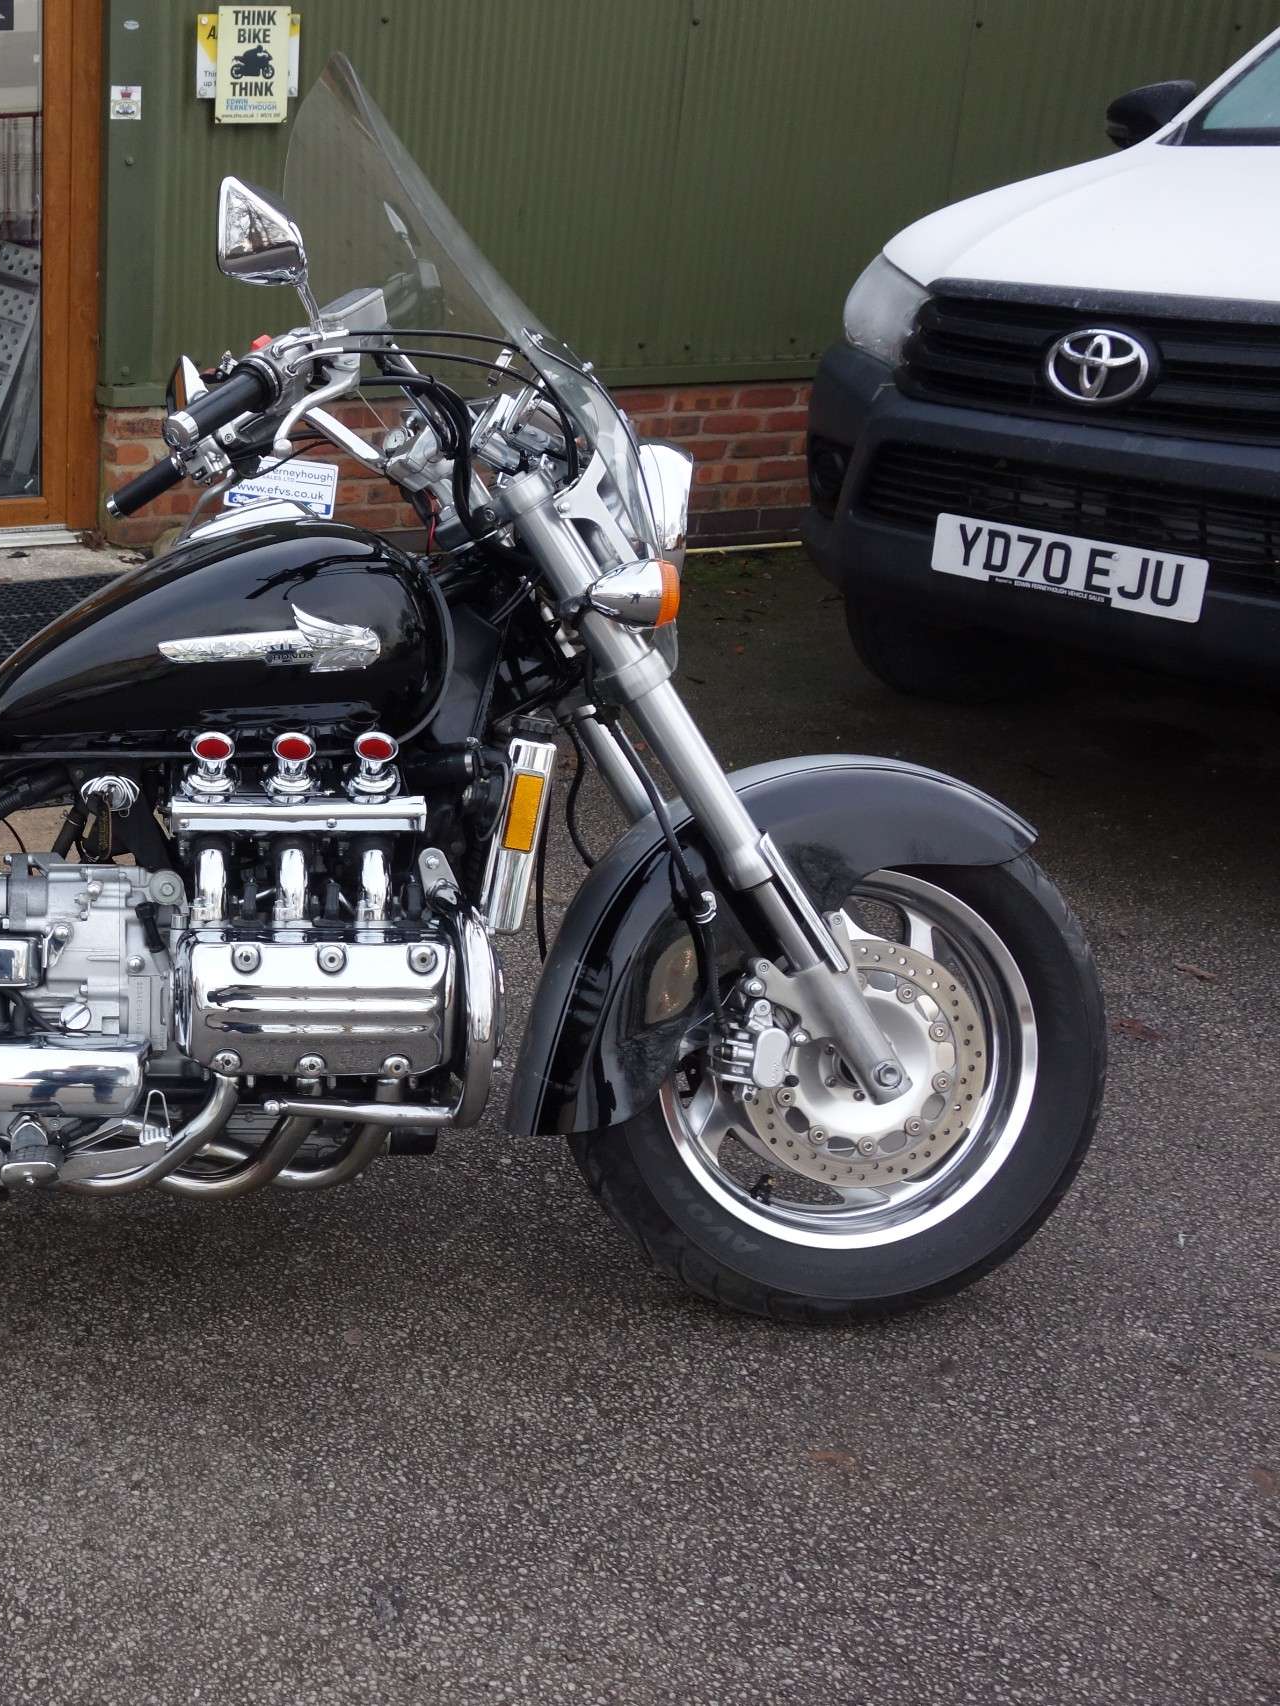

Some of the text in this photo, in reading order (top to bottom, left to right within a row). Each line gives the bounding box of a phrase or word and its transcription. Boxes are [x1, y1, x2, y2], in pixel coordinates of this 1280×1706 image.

[233, 10, 277, 26] THINK
[237, 28, 271, 44] BIKE
[229, 81, 274, 97] THINK
[272, 467, 334, 482] erneyhough
[237, 482, 325, 501] www.efvs.co.uk
[959, 523, 1184, 608] YD70 EJU
